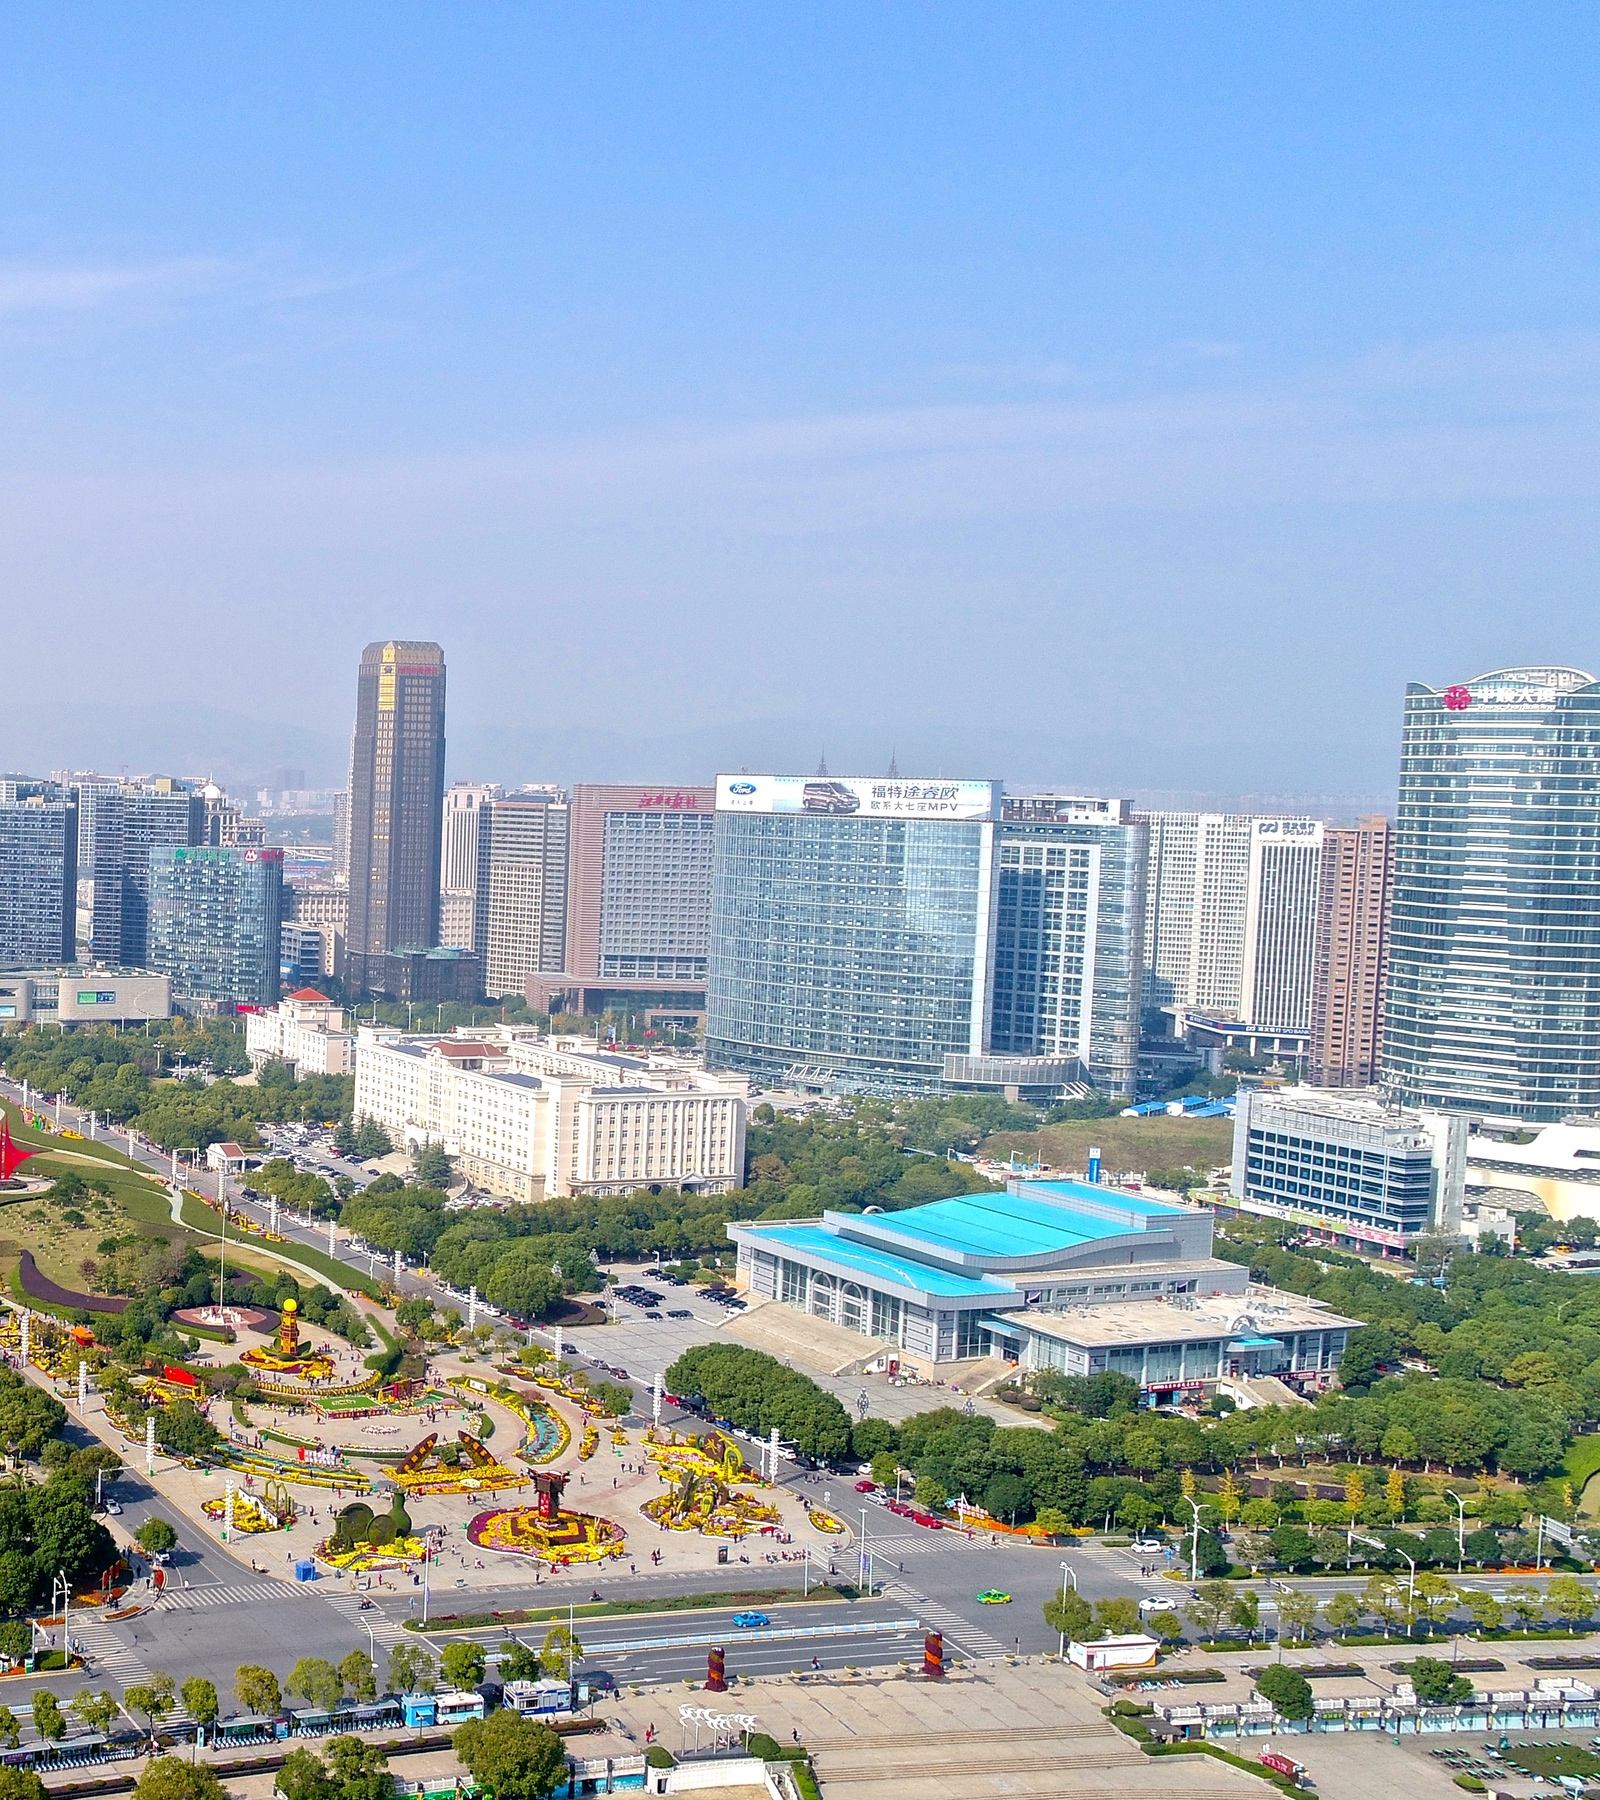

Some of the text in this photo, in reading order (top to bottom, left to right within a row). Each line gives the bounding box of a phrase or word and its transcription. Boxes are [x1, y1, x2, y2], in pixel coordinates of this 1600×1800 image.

[871, 785, 960, 800] 福特途睿欧
